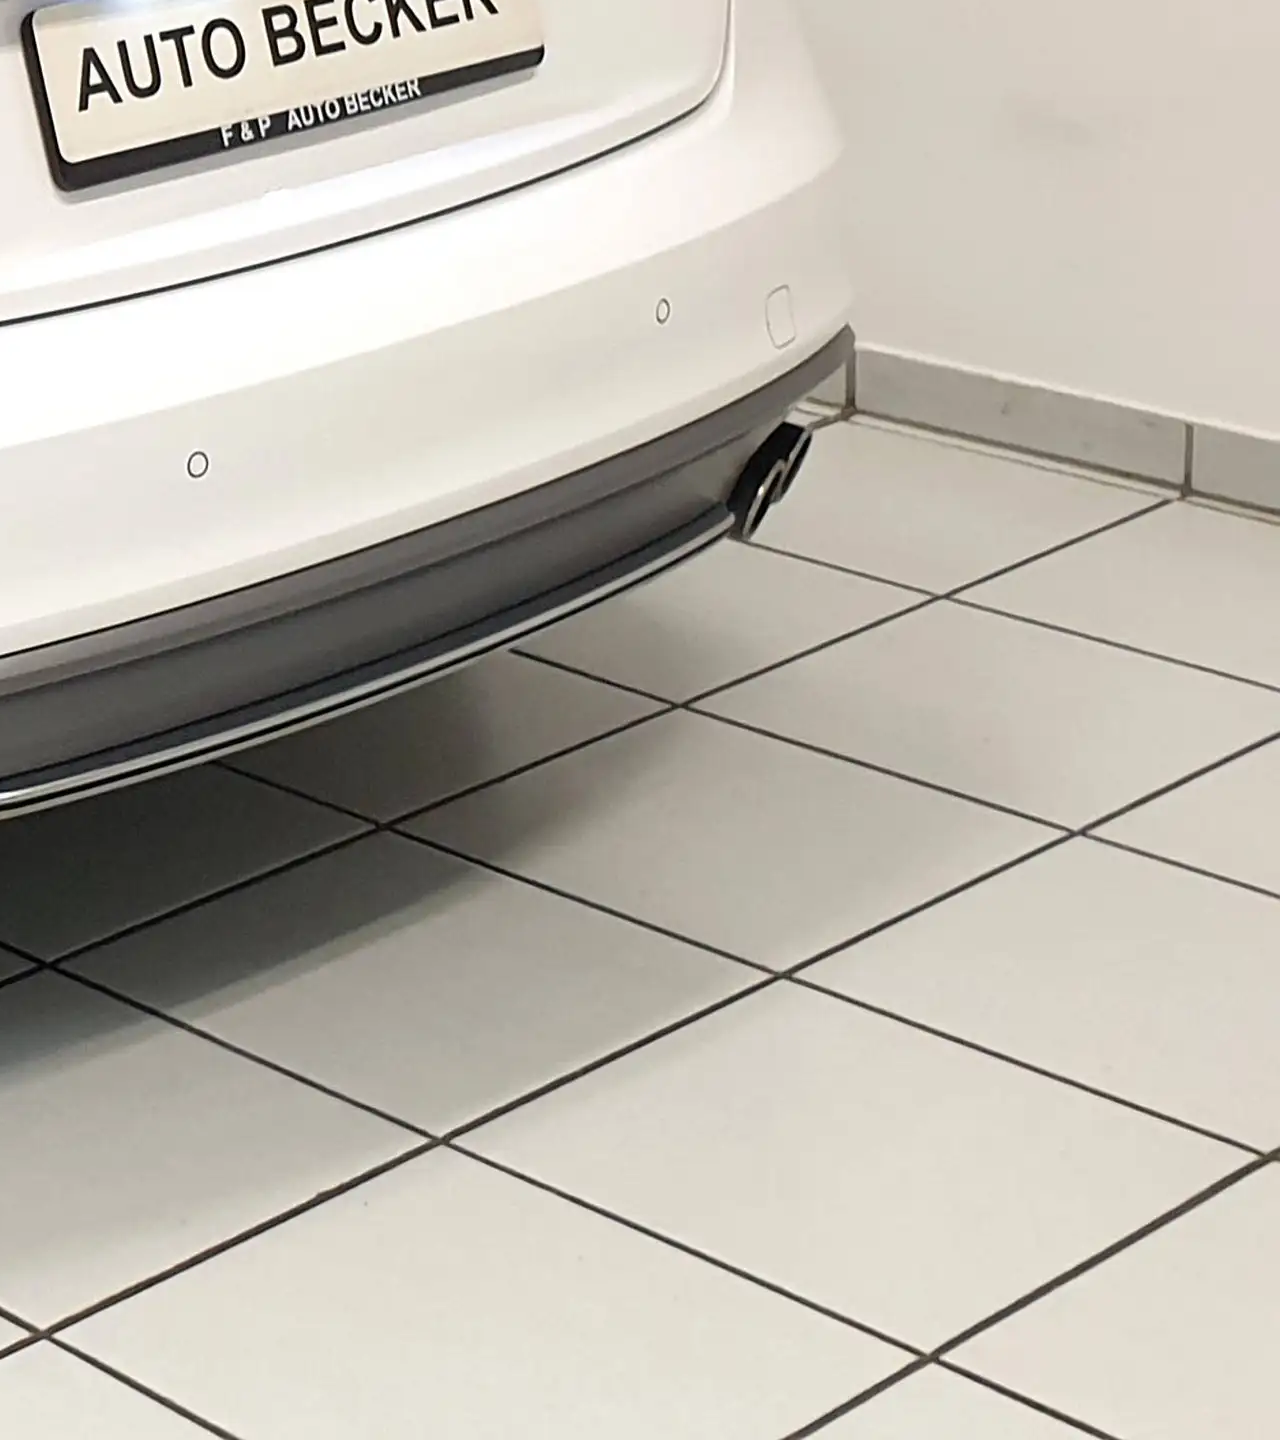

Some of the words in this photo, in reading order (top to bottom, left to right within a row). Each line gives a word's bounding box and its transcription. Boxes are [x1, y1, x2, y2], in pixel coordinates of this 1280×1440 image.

[77, 17, 246, 113] AUTO
[220, 123, 234, 147] F
[240, 120, 255, 142] &
[258, 116, 272, 138] P
[287, 100, 341, 131] AUTO
[344, 78, 422, 115] BECKER
